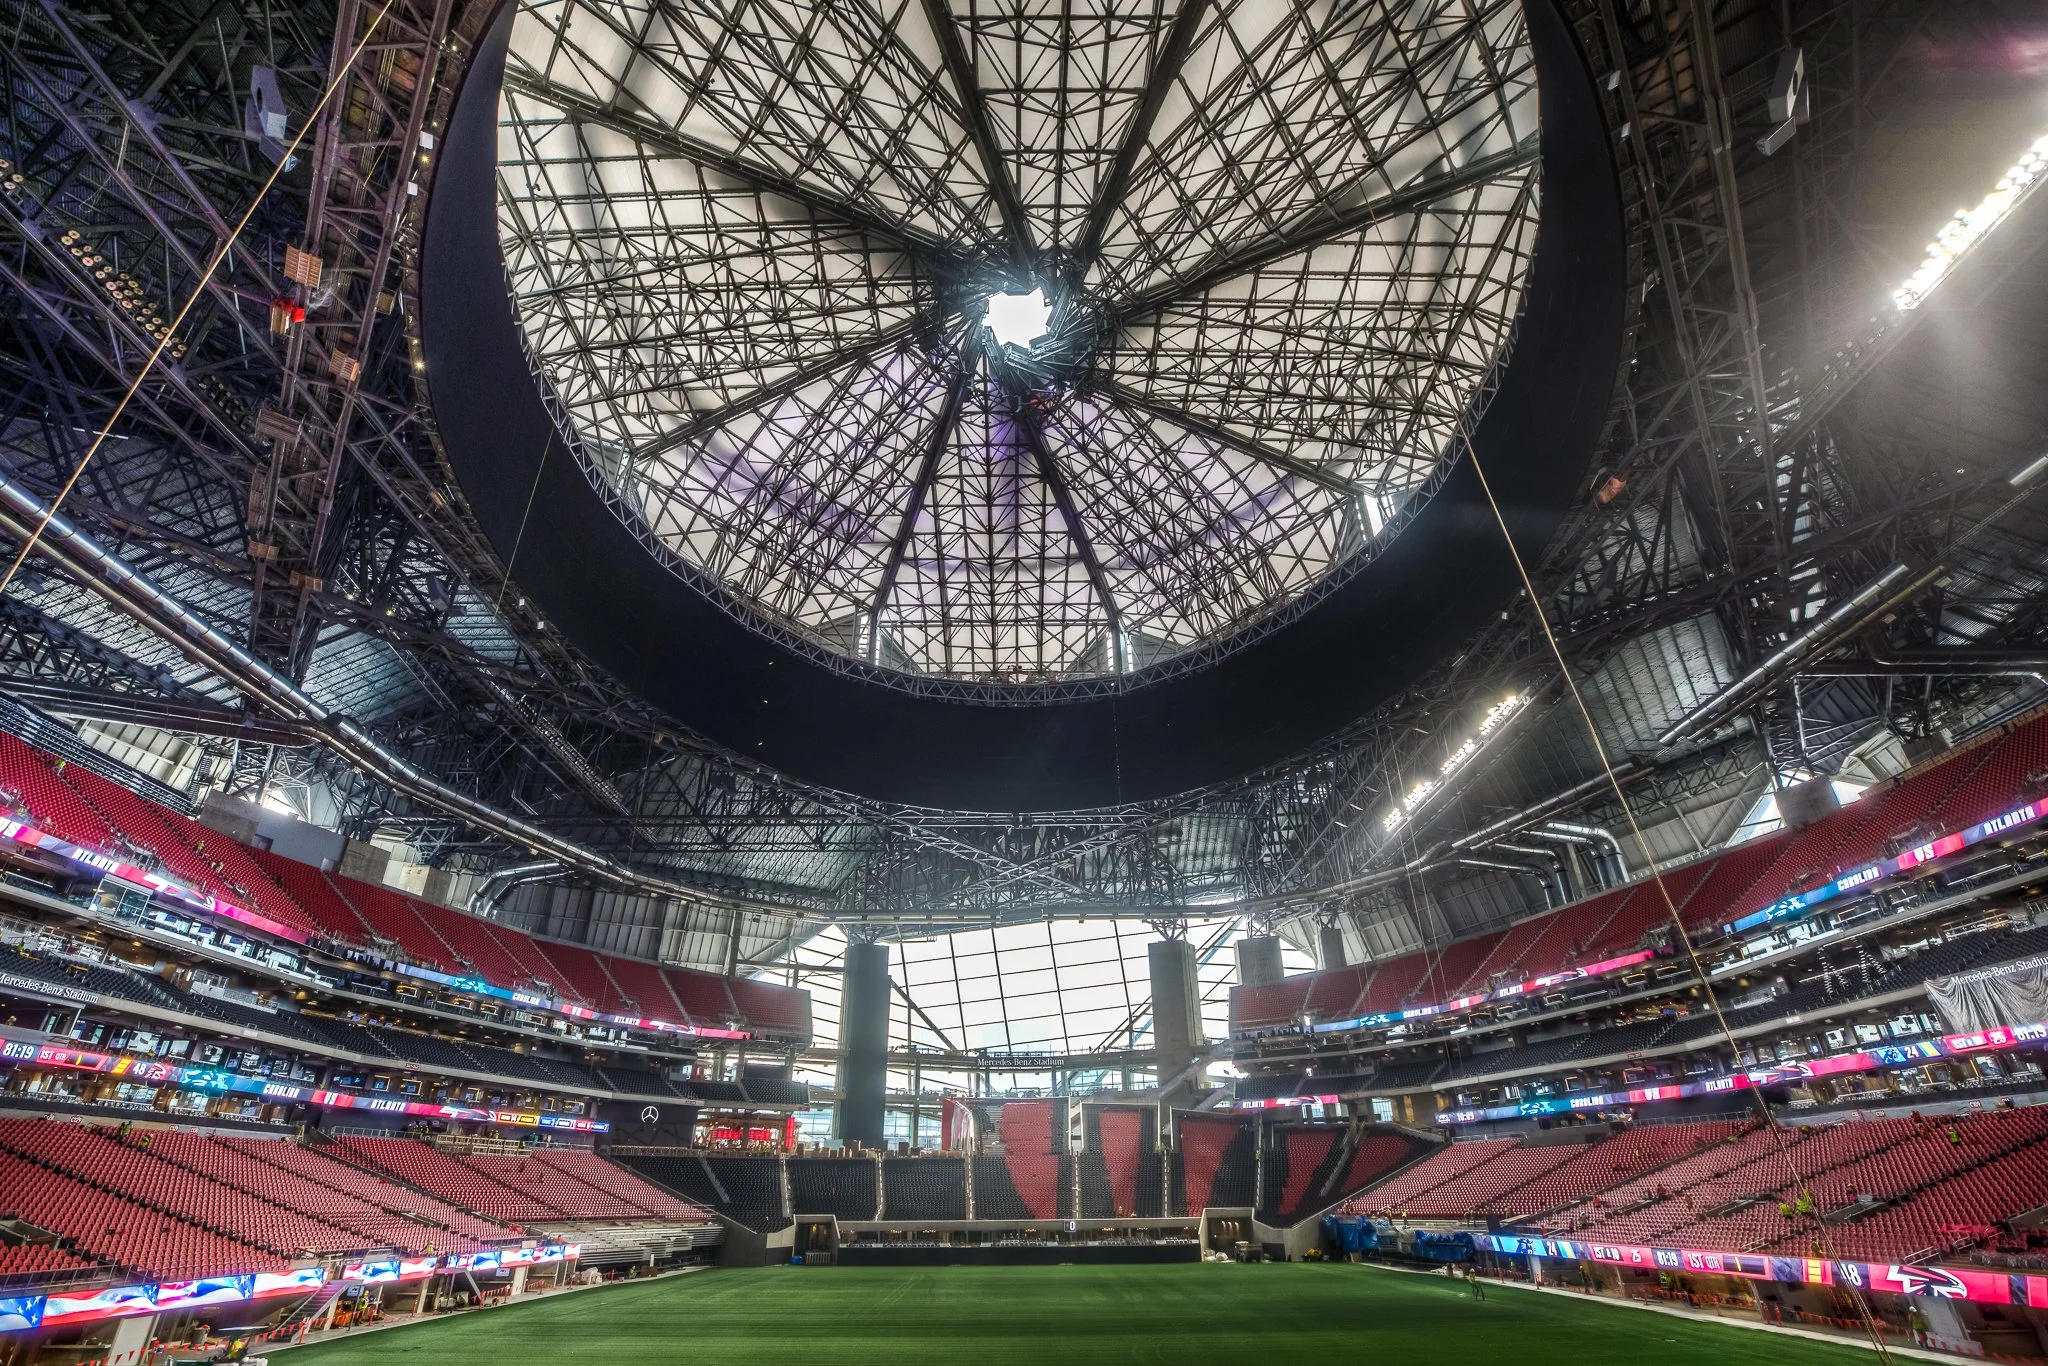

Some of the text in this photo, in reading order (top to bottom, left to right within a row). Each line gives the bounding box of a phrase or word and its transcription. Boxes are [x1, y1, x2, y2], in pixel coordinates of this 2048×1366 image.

[1983, 805, 2036, 836] ATLANTA
[1951, 956, 2048, 985] Mercedes-Benz Stadiu
[0, 973, 99, 1004] Mercedes-Benz Stadium
[1500, 984, 1523, 997] ATLANTA
[614, 1015, 640, 1026] ATLANTA
[2, 1043, 146, 1075] 81:19 1ST QTR 48
[1904, 1045, 1919, 1059] 24
[977, 1056, 1065, 1067] Mercedes-Benz Stadium
[1705, 1077, 1734, 1092] ATLANTA
[370, 1099, 406, 1112] ATLANTA
[1547, 1241, 1557, 1256] 24
[1593, 1246, 1605, 1260] 1ST
[1612, 1247, 1620, 1261] 10
[1630, 1249, 1641, 1263] 25
[1656, 1251, 1679, 1267] 81:19
[1687, 1253, 1704, 1269] 1ST
[1705, 1255, 1721, 1270] QTR
